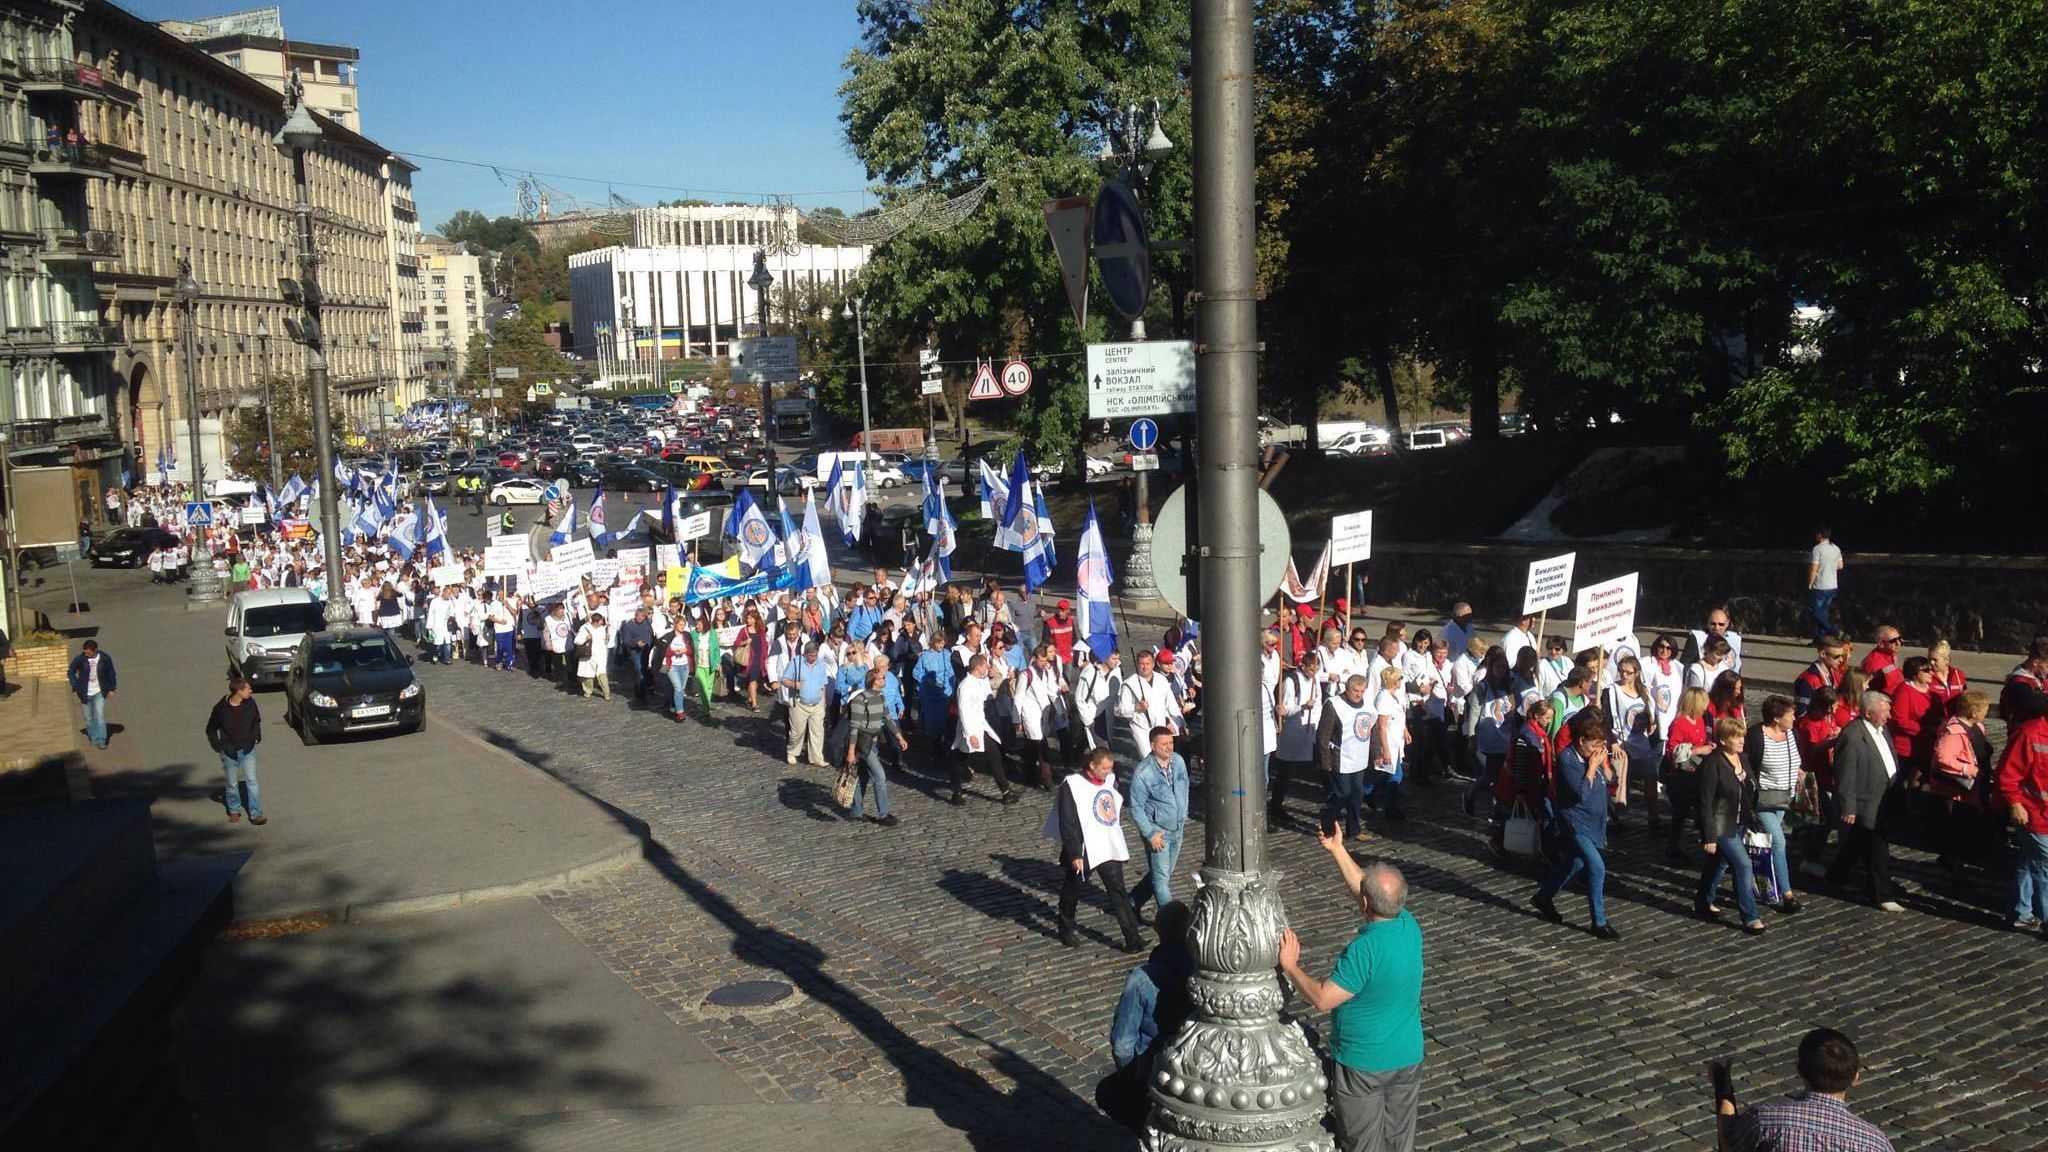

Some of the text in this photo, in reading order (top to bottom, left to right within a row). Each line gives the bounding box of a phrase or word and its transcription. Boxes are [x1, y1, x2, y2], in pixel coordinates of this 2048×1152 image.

[1105, 348, 1133, 356] ЦЕНТР
[1106, 366, 1156, 376] залізничний
[1008, 371, 1026, 385] 40
[1106, 376, 1141, 385] ВОКЗАЛ
[1106, 397, 1125, 406] НСК
[1535, 563, 1567, 576] Вимагаємо
[1591, 587, 1624, 602] Припиніть
